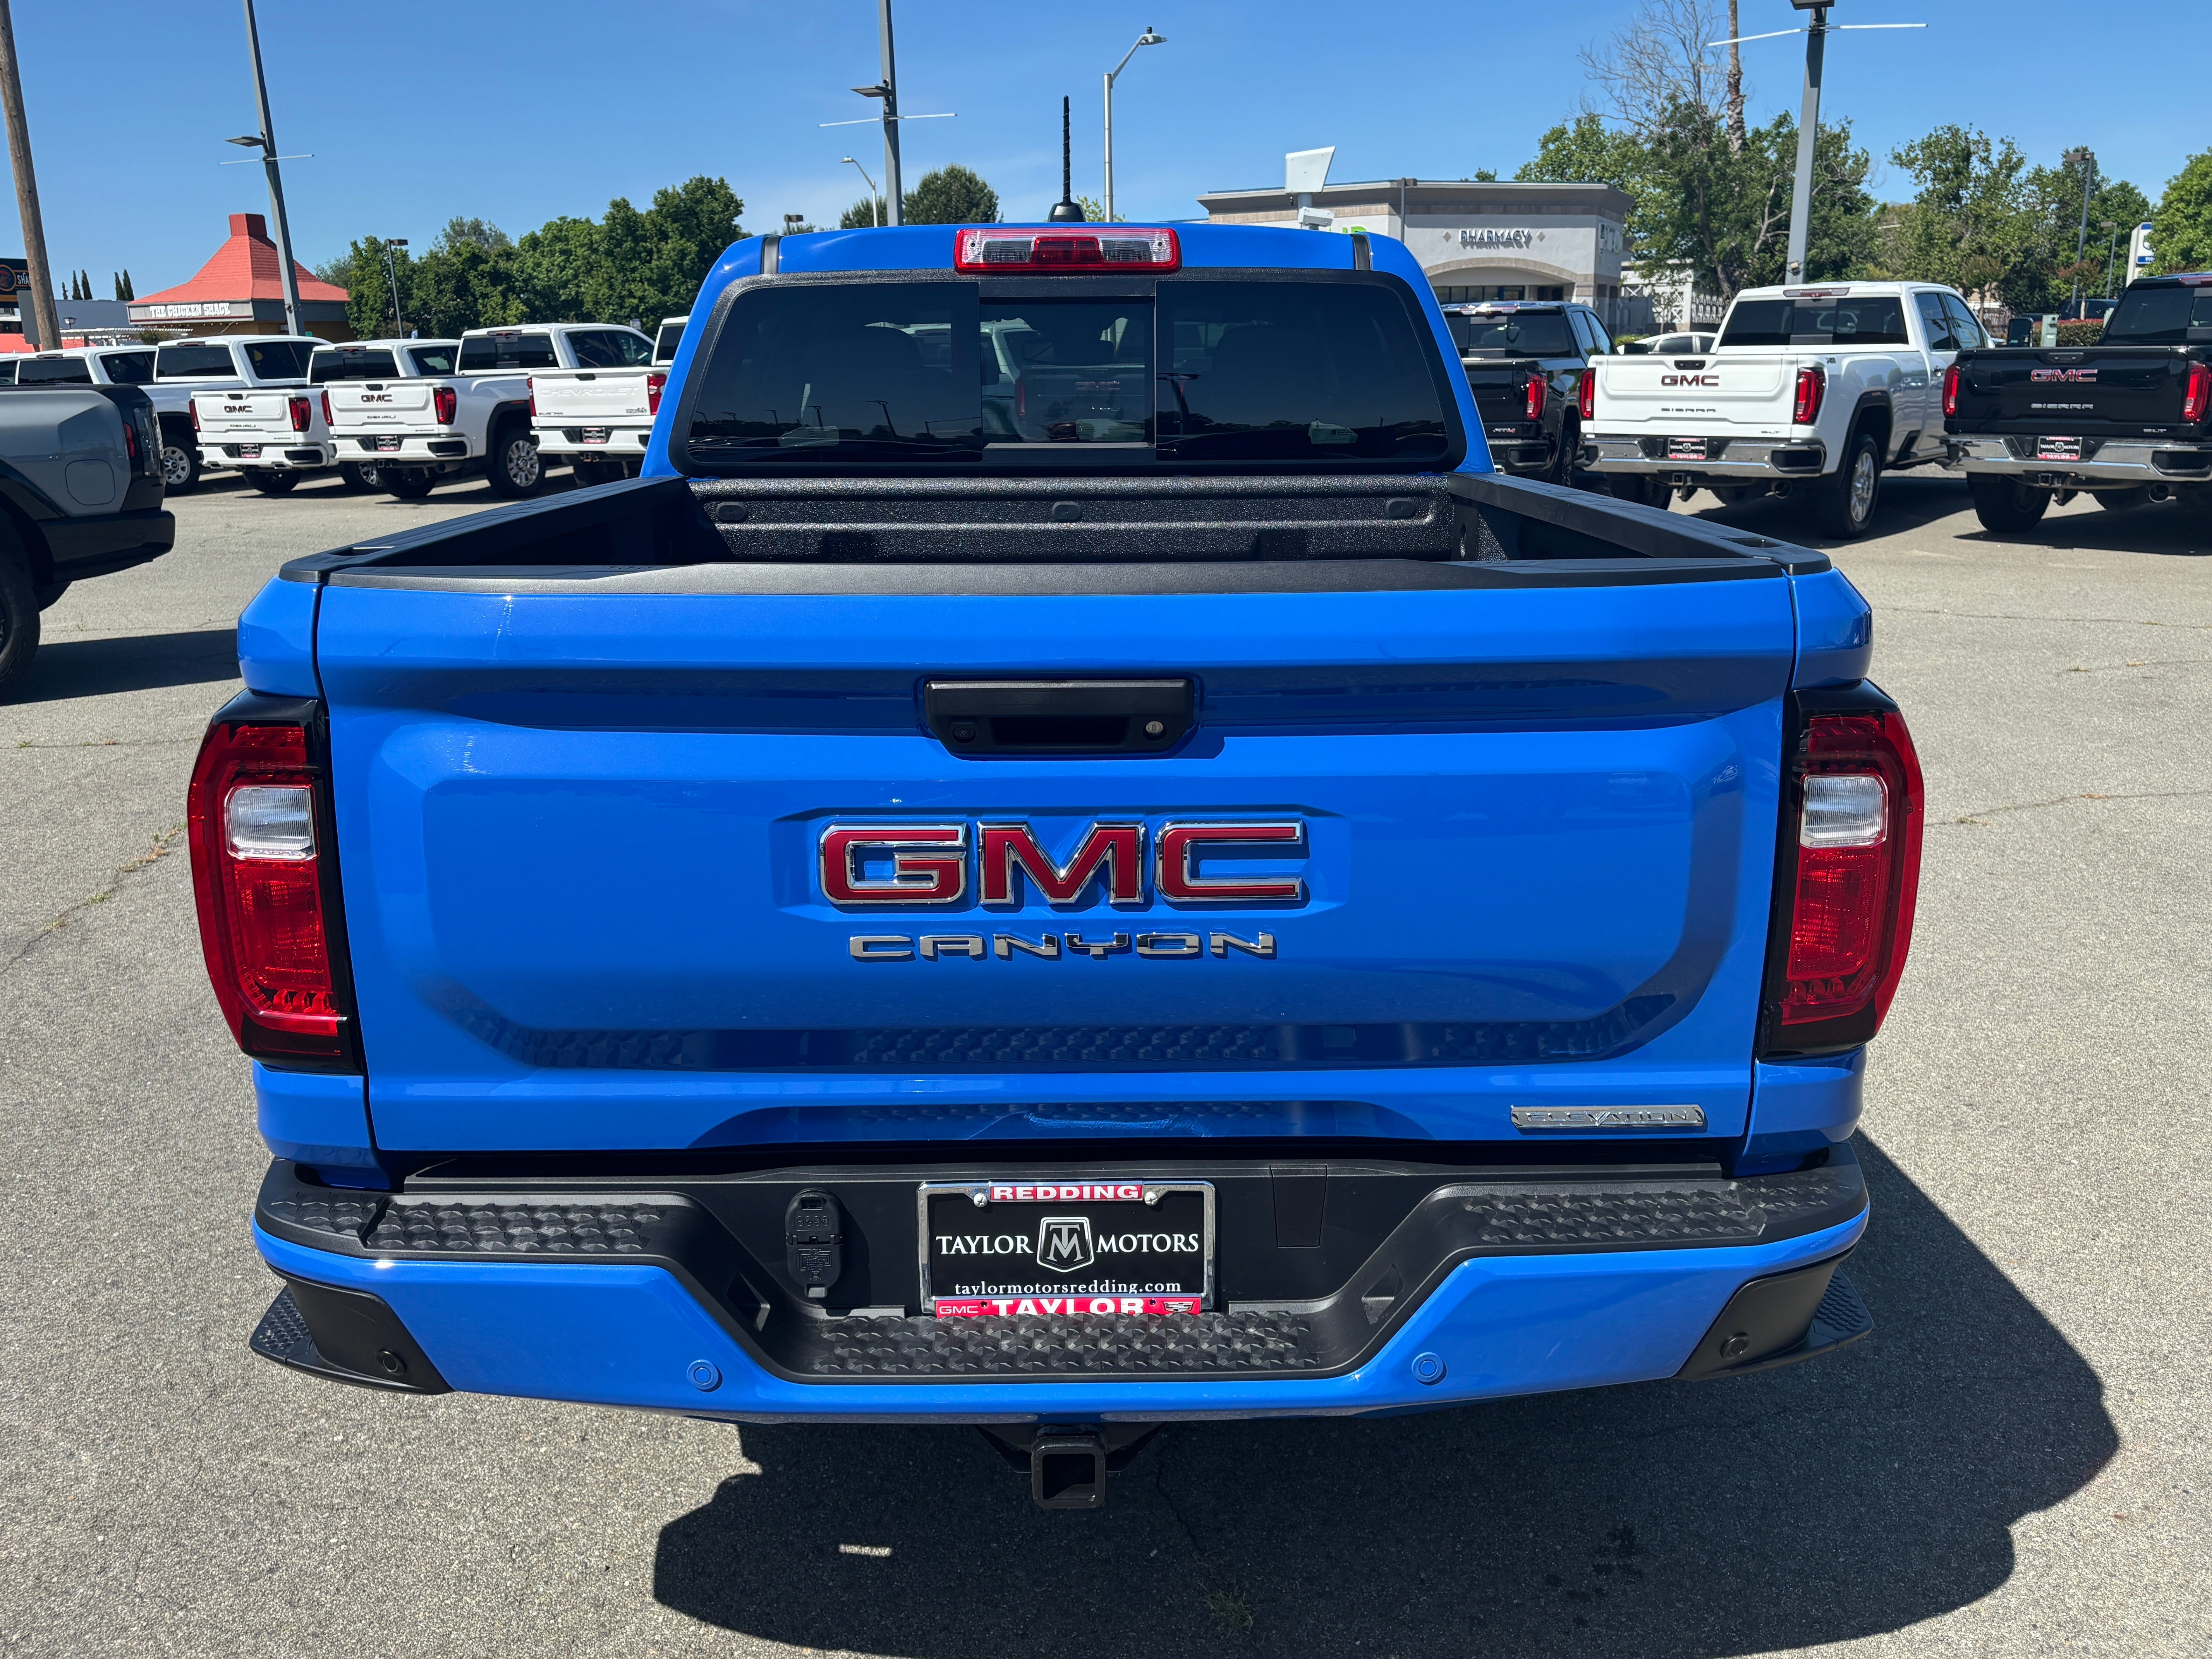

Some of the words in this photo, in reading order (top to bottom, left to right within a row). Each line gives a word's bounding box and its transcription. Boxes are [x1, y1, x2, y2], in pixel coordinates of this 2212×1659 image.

[1458, 229, 1530, 242] PHARMACY
[149, 305, 167, 318] THE
[167, 304, 202, 318] CHICKEN
[203, 303, 231, 316] SHACK
[1661, 375, 1719, 386] GMC
[2031, 369, 2098, 382] GMC
[361, 394, 393, 403] GMC
[540, 387, 639, 397] CHEVROLET
[819, 821, 1303, 904] GMC
[849, 932, 1274, 957] CANYON
[1526, 1110, 1689, 1125] ELEVATION
[993, 1186, 1139, 1200] REDDING
[936, 1235, 1034, 1255] TAYLOR
[1096, 1233, 1199, 1253] MOTORS
[955, 1279, 1181, 1296] taylormotorsredding.com
[939, 1305, 979, 1314] GMC
[991, 1298, 1144, 1316] TAYLOR
